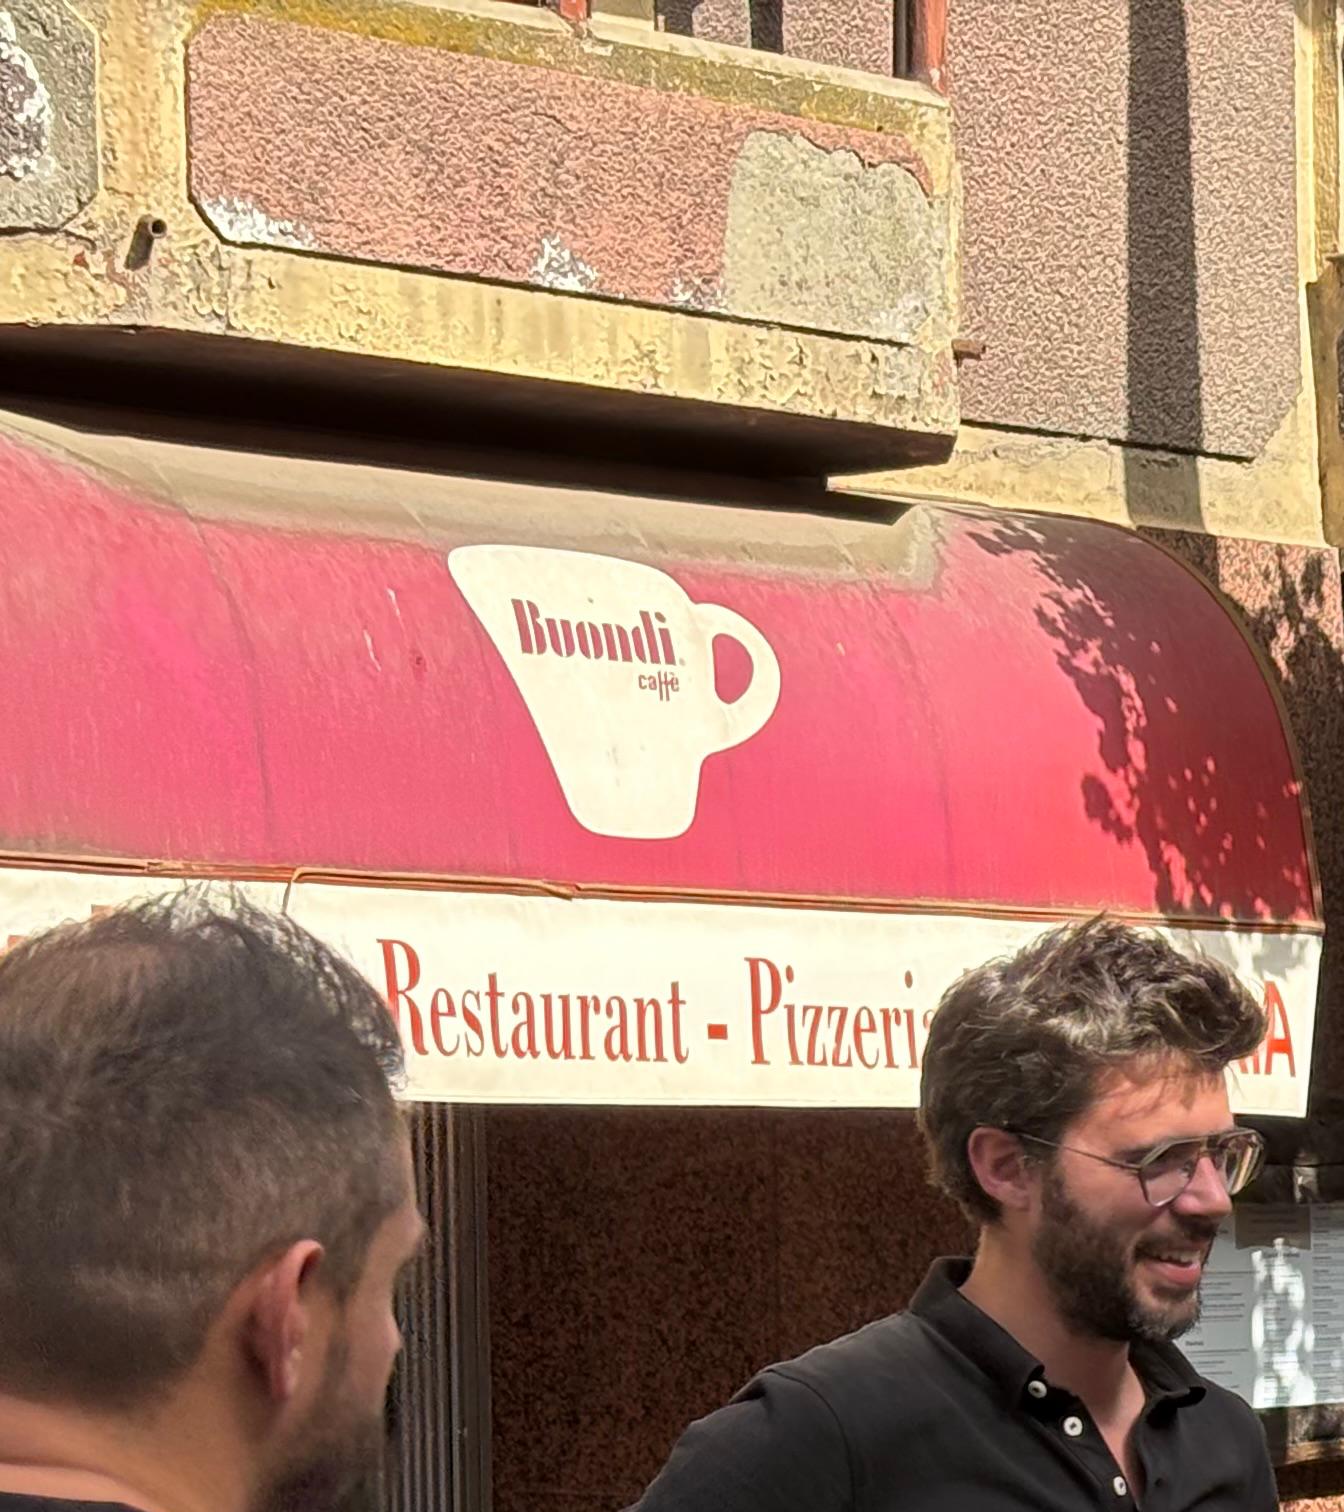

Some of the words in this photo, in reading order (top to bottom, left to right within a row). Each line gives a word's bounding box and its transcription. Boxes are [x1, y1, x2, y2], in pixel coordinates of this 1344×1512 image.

[638, 671, 680, 702] caffè
[376, 938, 689, 1064] Restaurant
[744, 957, 936, 1069] Pizzeri
